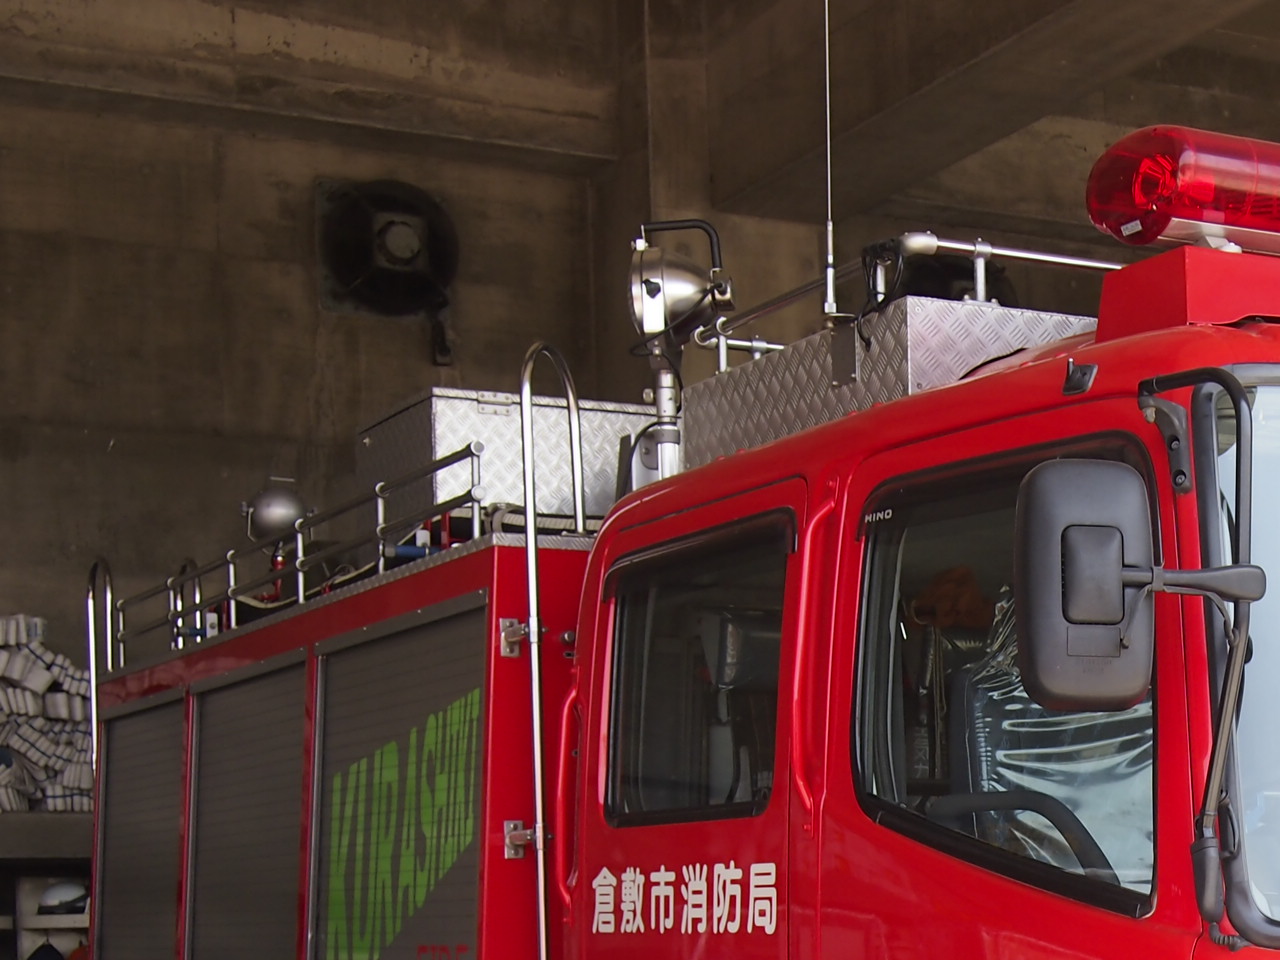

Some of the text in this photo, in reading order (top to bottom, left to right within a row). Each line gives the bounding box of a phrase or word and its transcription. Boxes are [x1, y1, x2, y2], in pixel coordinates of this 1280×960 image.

[864, 508, 893, 523] HINO
[592, 860, 777, 935] 倉敷市消防局
